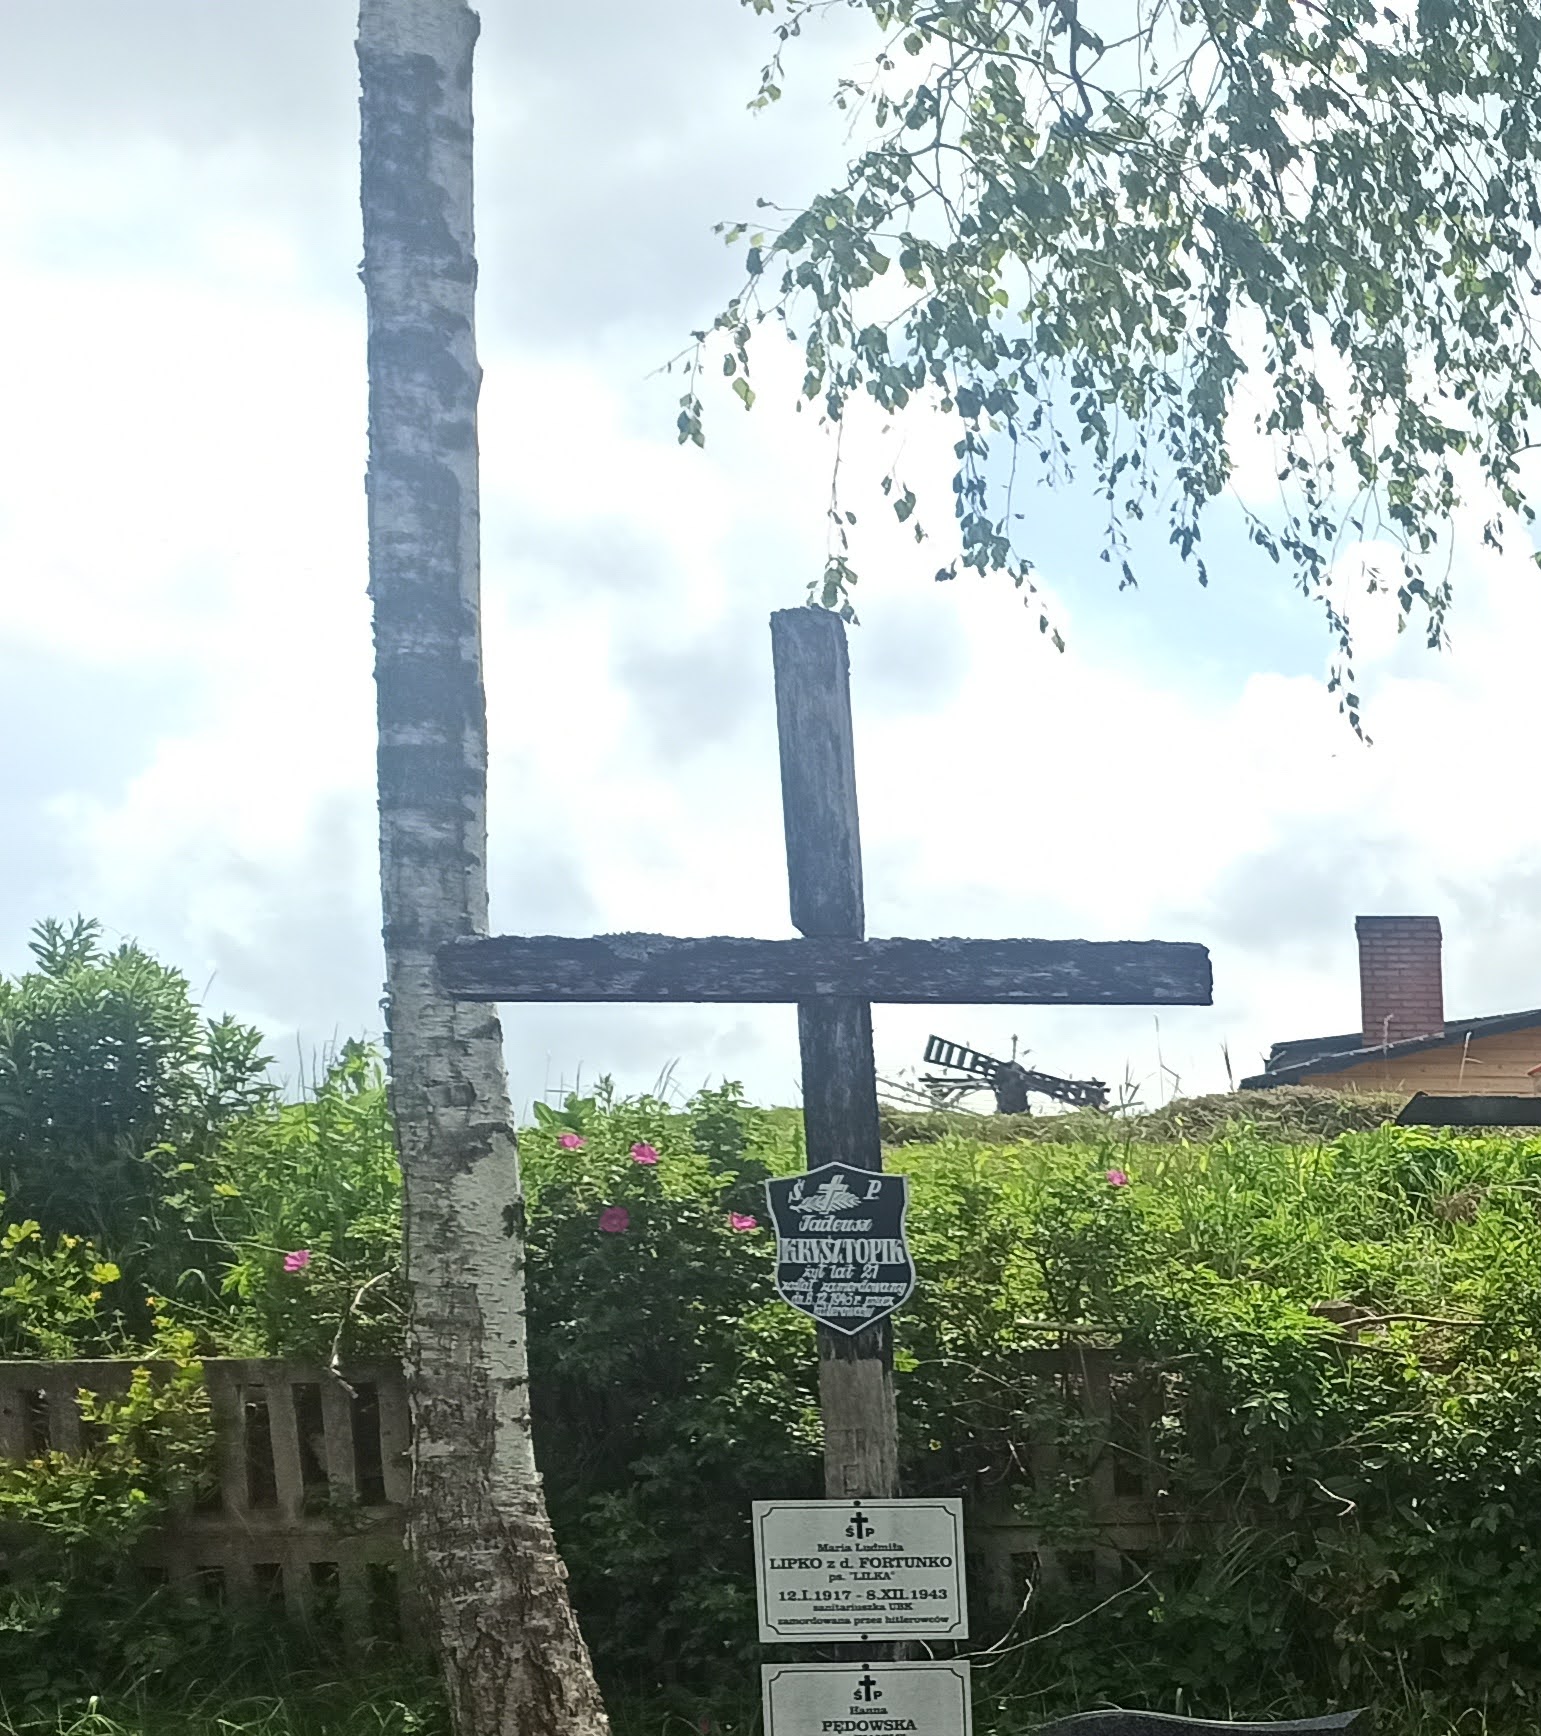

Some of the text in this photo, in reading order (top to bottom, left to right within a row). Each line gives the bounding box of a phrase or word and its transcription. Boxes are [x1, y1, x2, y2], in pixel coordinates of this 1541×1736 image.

[829, 1264, 856, 1278] lat
[861, 1264, 879, 1278] 21
[865, 1528, 875, 1538] P
[817, 1543, 904, 1552] Maria Ludmiła
[770, 1558, 823, 1569] LIPKO
[827, 1560, 836, 1568] z
[859, 1556, 952, 1569] FORTUNKO
[829, 1573, 845, 1583] ps.
[778, 1589, 948, 1601] 12.I.1917 8.XII.1943
[813, 1604, 886, 1612] sanitariuszka
[778, 1616, 949, 1626] zamordowana przez hitlerowców
[873, 1690, 883, 1700] P
[849, 1706, 888, 1715] Hanna
[821, 1720, 917, 1734] PĘDOWSKA
